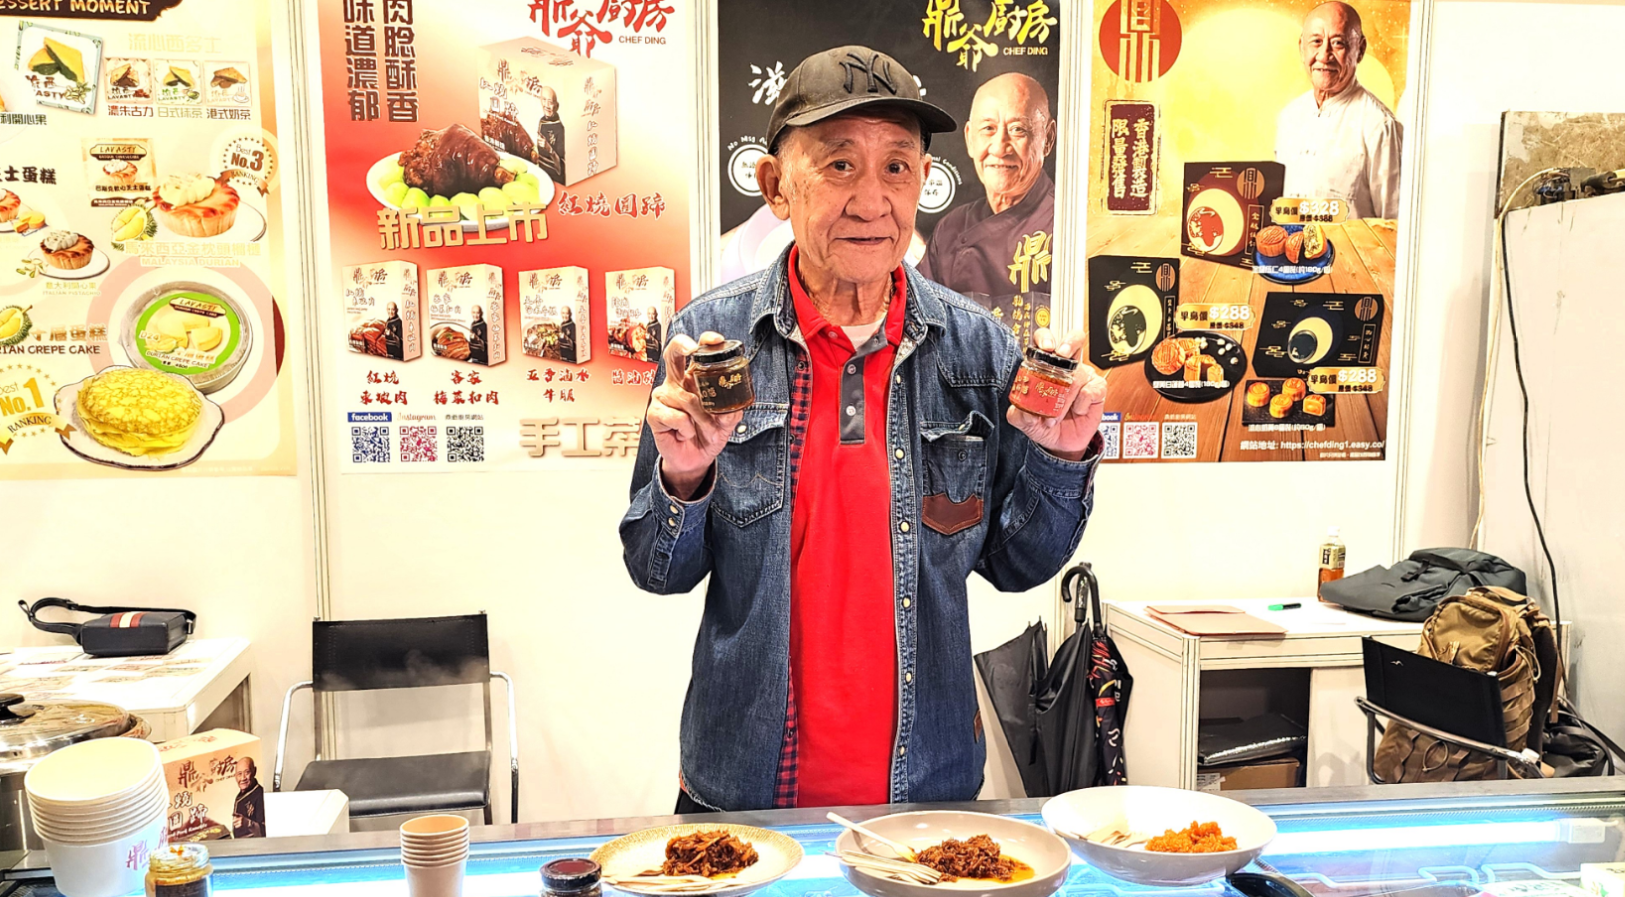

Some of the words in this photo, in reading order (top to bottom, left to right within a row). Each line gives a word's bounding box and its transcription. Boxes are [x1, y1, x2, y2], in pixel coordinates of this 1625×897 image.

[70, 0, 150, 14] MOMENT
[128, 32, 222, 54] 流心西多士
[618, 35, 642, 44] CHEF
[644, 36, 667, 45] DING
[1003, 46, 1027, 56] CHEF
[1027, 46, 1048, 56] DING
[107, 104, 154, 118] 濃朱古力
[206, 107, 251, 120] 港式奶茶
[0, 113, 48, 125] 利開心果
[99, 146, 137, 154] LAVASTY
[231, 150, 264, 171] No.3
[1130, 117, 1150, 198] 香港製造
[0, 165, 57, 185] 士蛋糕
[1299, 200, 1340, 216] $328
[376, 201, 548, 250] 新品上市
[142, 258, 196, 266] MALAYSIA
[199, 258, 240, 267] DURIAN
[1209, 305, 1250, 320] $288
[28, 345, 66, 354] CREPE
[69, 345, 101, 354] CAKE
[366, 370, 400, 384] 紅燒
[451, 370, 482, 385] 客家
[1310, 374, 1336, 384] 早鳥價
[1338, 368, 1377, 383] $288
[360, 390, 408, 405] 東坡肉
[7, 415, 52, 433] RANKING
[351, 413, 388, 421] facebook
[397, 412, 436, 422] Instagram
[168, 791, 192, 809] 燒
